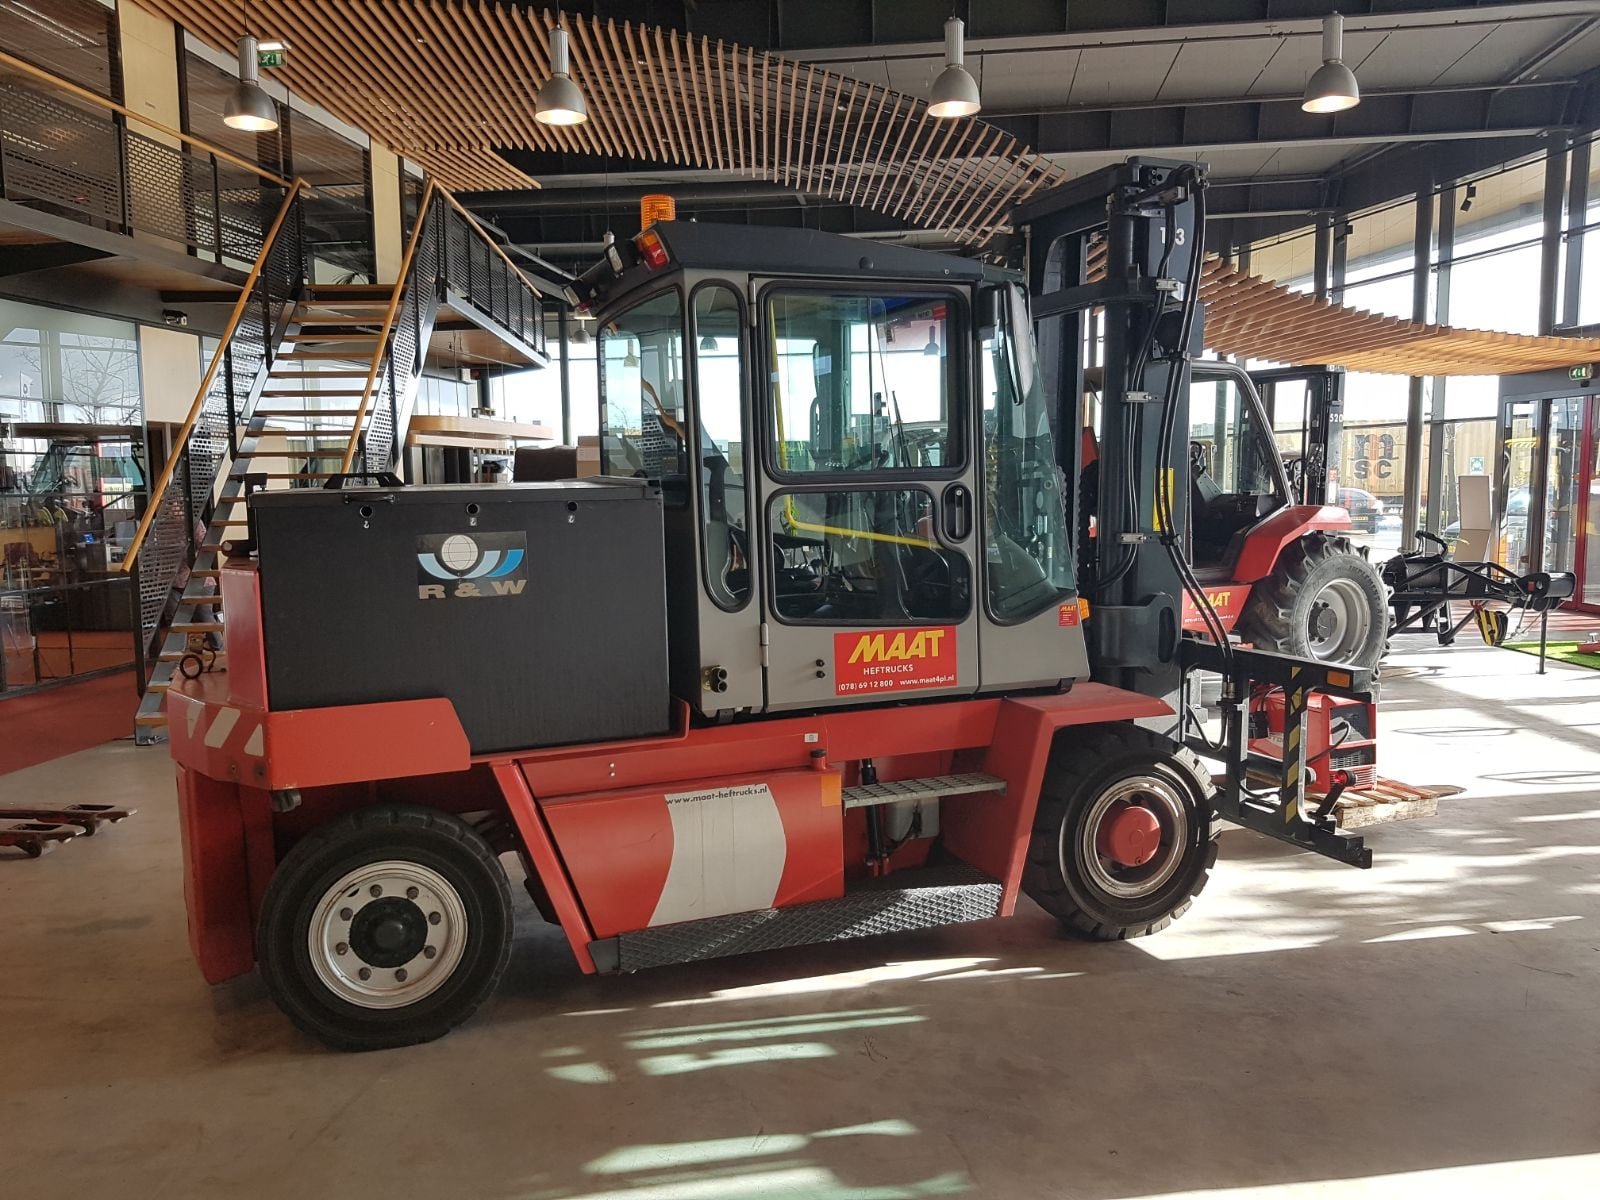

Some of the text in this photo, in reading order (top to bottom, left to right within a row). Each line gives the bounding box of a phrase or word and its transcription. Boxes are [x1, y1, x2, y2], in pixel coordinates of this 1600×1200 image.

[1329, 413, 1343, 423] 520
[418, 579, 527, 600] R & W
[847, 629, 945, 664] MAAT
[863, 664, 914, 676] HEFTRUCKS
[838, 683, 857, 692] (078)
[858, 681, 868, 690] 69
[879, 679, 894, 687] 800
[899, 674, 955, 686] www.maat4pl.nl
[666, 785, 768, 805] www.maat-heftrucks.nl
